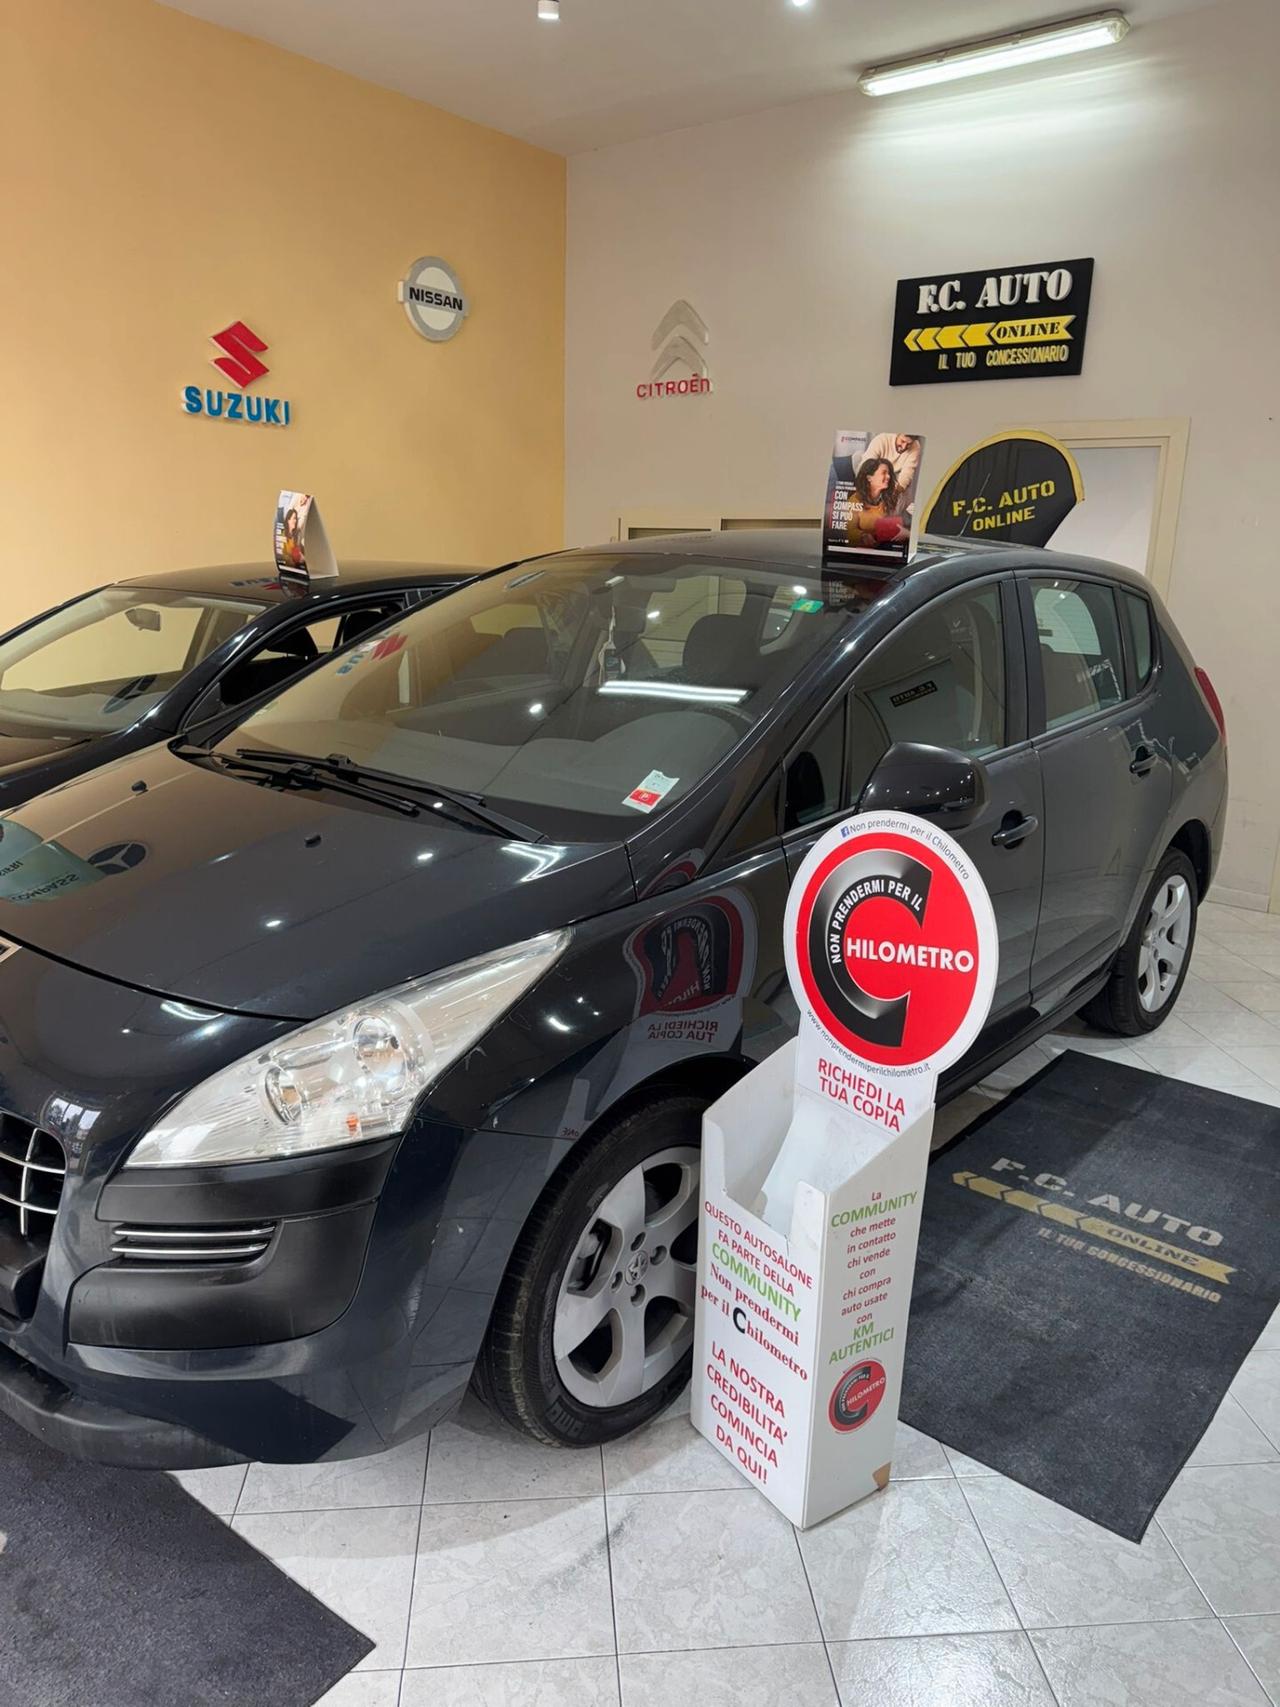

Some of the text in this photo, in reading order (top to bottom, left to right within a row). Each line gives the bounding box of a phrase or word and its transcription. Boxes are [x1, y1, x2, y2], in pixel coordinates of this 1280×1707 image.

[409, 287, 463, 311] NISSAN
[917, 269, 1073, 314] F.C. AUTO
[996, 321, 1060, 339] ONLINE
[937, 345, 1069, 370] IL TUO CONCESSIONARIO
[182, 386, 290, 426] SUZUKI
[833, 501, 864, 512] COMPASS
[834, 490, 848, 500] CON
[952, 480, 1056, 517] F.C. AUTO
[831, 521, 848, 531] FARE
[972, 506, 1036, 531] ONLINE
[849, 819, 970, 880] Non prendermi per il Chilometro
[829, 879, 923, 964] NON PRENDERMI PER IL
[806, 1009, 931, 1078] www.nonprendermiperilchilometro.it
[818, 1058, 905, 1115] RICHIEDI LA
[819, 1076, 900, 1132] TUA COPIA
[831, 1191, 918, 1228] COMMUNITY
[871, 1191, 882, 1202] La
[850, 1216, 896, 1238] che mette
[1087, 1193, 1224, 1247] AUTO
[704, 1201, 813, 1289] QUESTO AUTOSALONE
[847, 1231, 896, 1254] in contatto
[847, 1247, 891, 1269] chi vende
[1107, 1227, 1201, 1267] ONLINE
[718, 1229, 795, 1296] FA PARTE DELLA
[859, 1268, 876, 1280] con
[1087, 1245, 1222, 1303] CONCESSIONARIO
[712, 1243, 802, 1322] COMMUNITY
[842, 1276, 892, 1301] chi compra
[710, 1263, 800, 1347] Non prendermi
[841, 1291, 888, 1316] auto usate
[856, 1312, 873, 1325] con
[701, 1284, 808, 1381] per il Chilometro
[829, 1327, 895, 1365] AUTENTICI
[853, 1321, 875, 1340] KM
[711, 1341, 726, 1367] LA
[729, 1358, 786, 1418] NOSTRA
[710, 1394, 778, 1468] COMINCIA
[716, 1424, 768, 1485] DA QUI!
